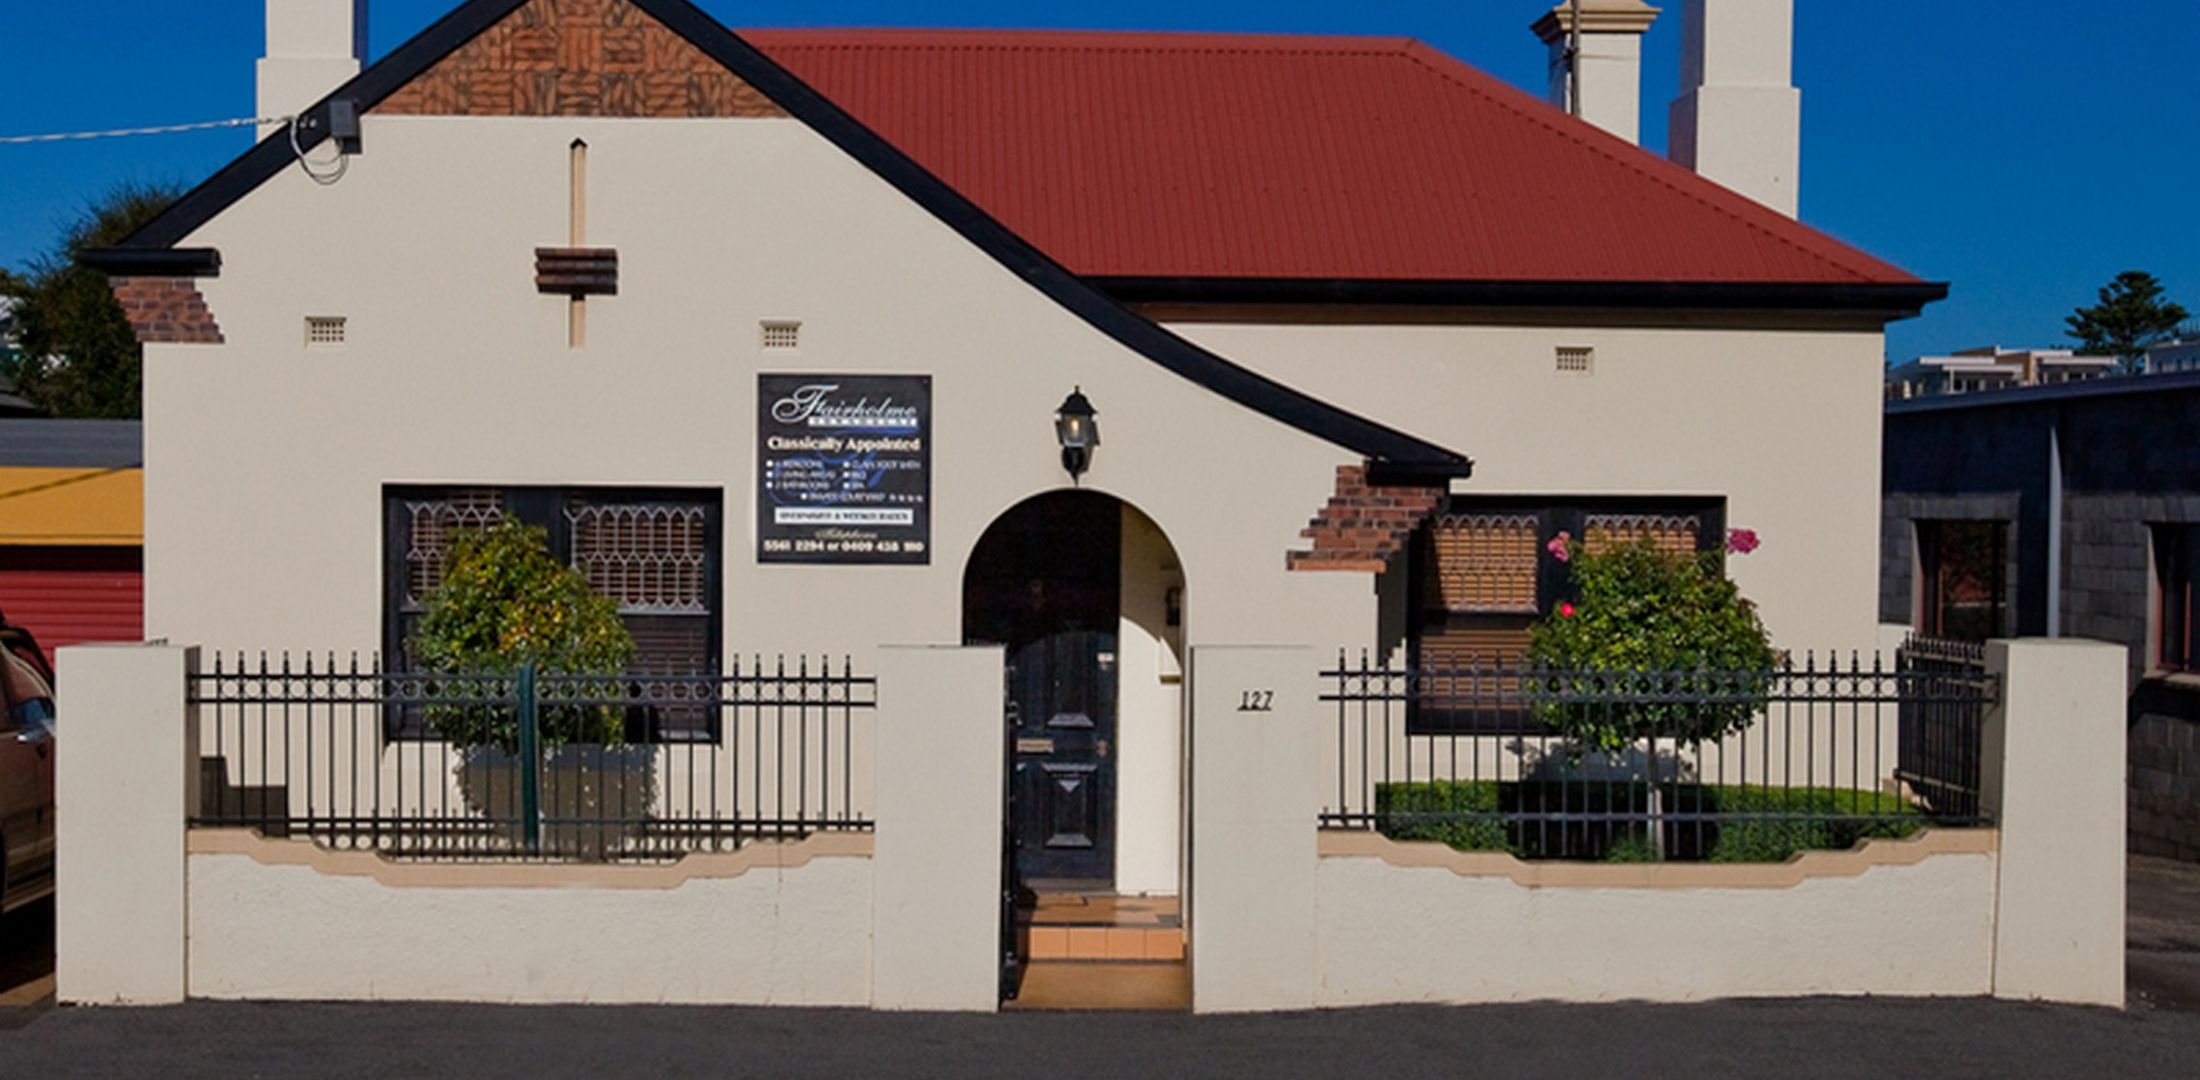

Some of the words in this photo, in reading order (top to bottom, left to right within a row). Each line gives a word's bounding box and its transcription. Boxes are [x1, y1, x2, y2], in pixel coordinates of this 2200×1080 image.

[772, 384, 917, 423] Fairholme
[767, 437, 842, 452] Classically
[845, 437, 921, 452] Appointed
[827, 543, 840, 552] or
[1237, 690, 1274, 712] 127
